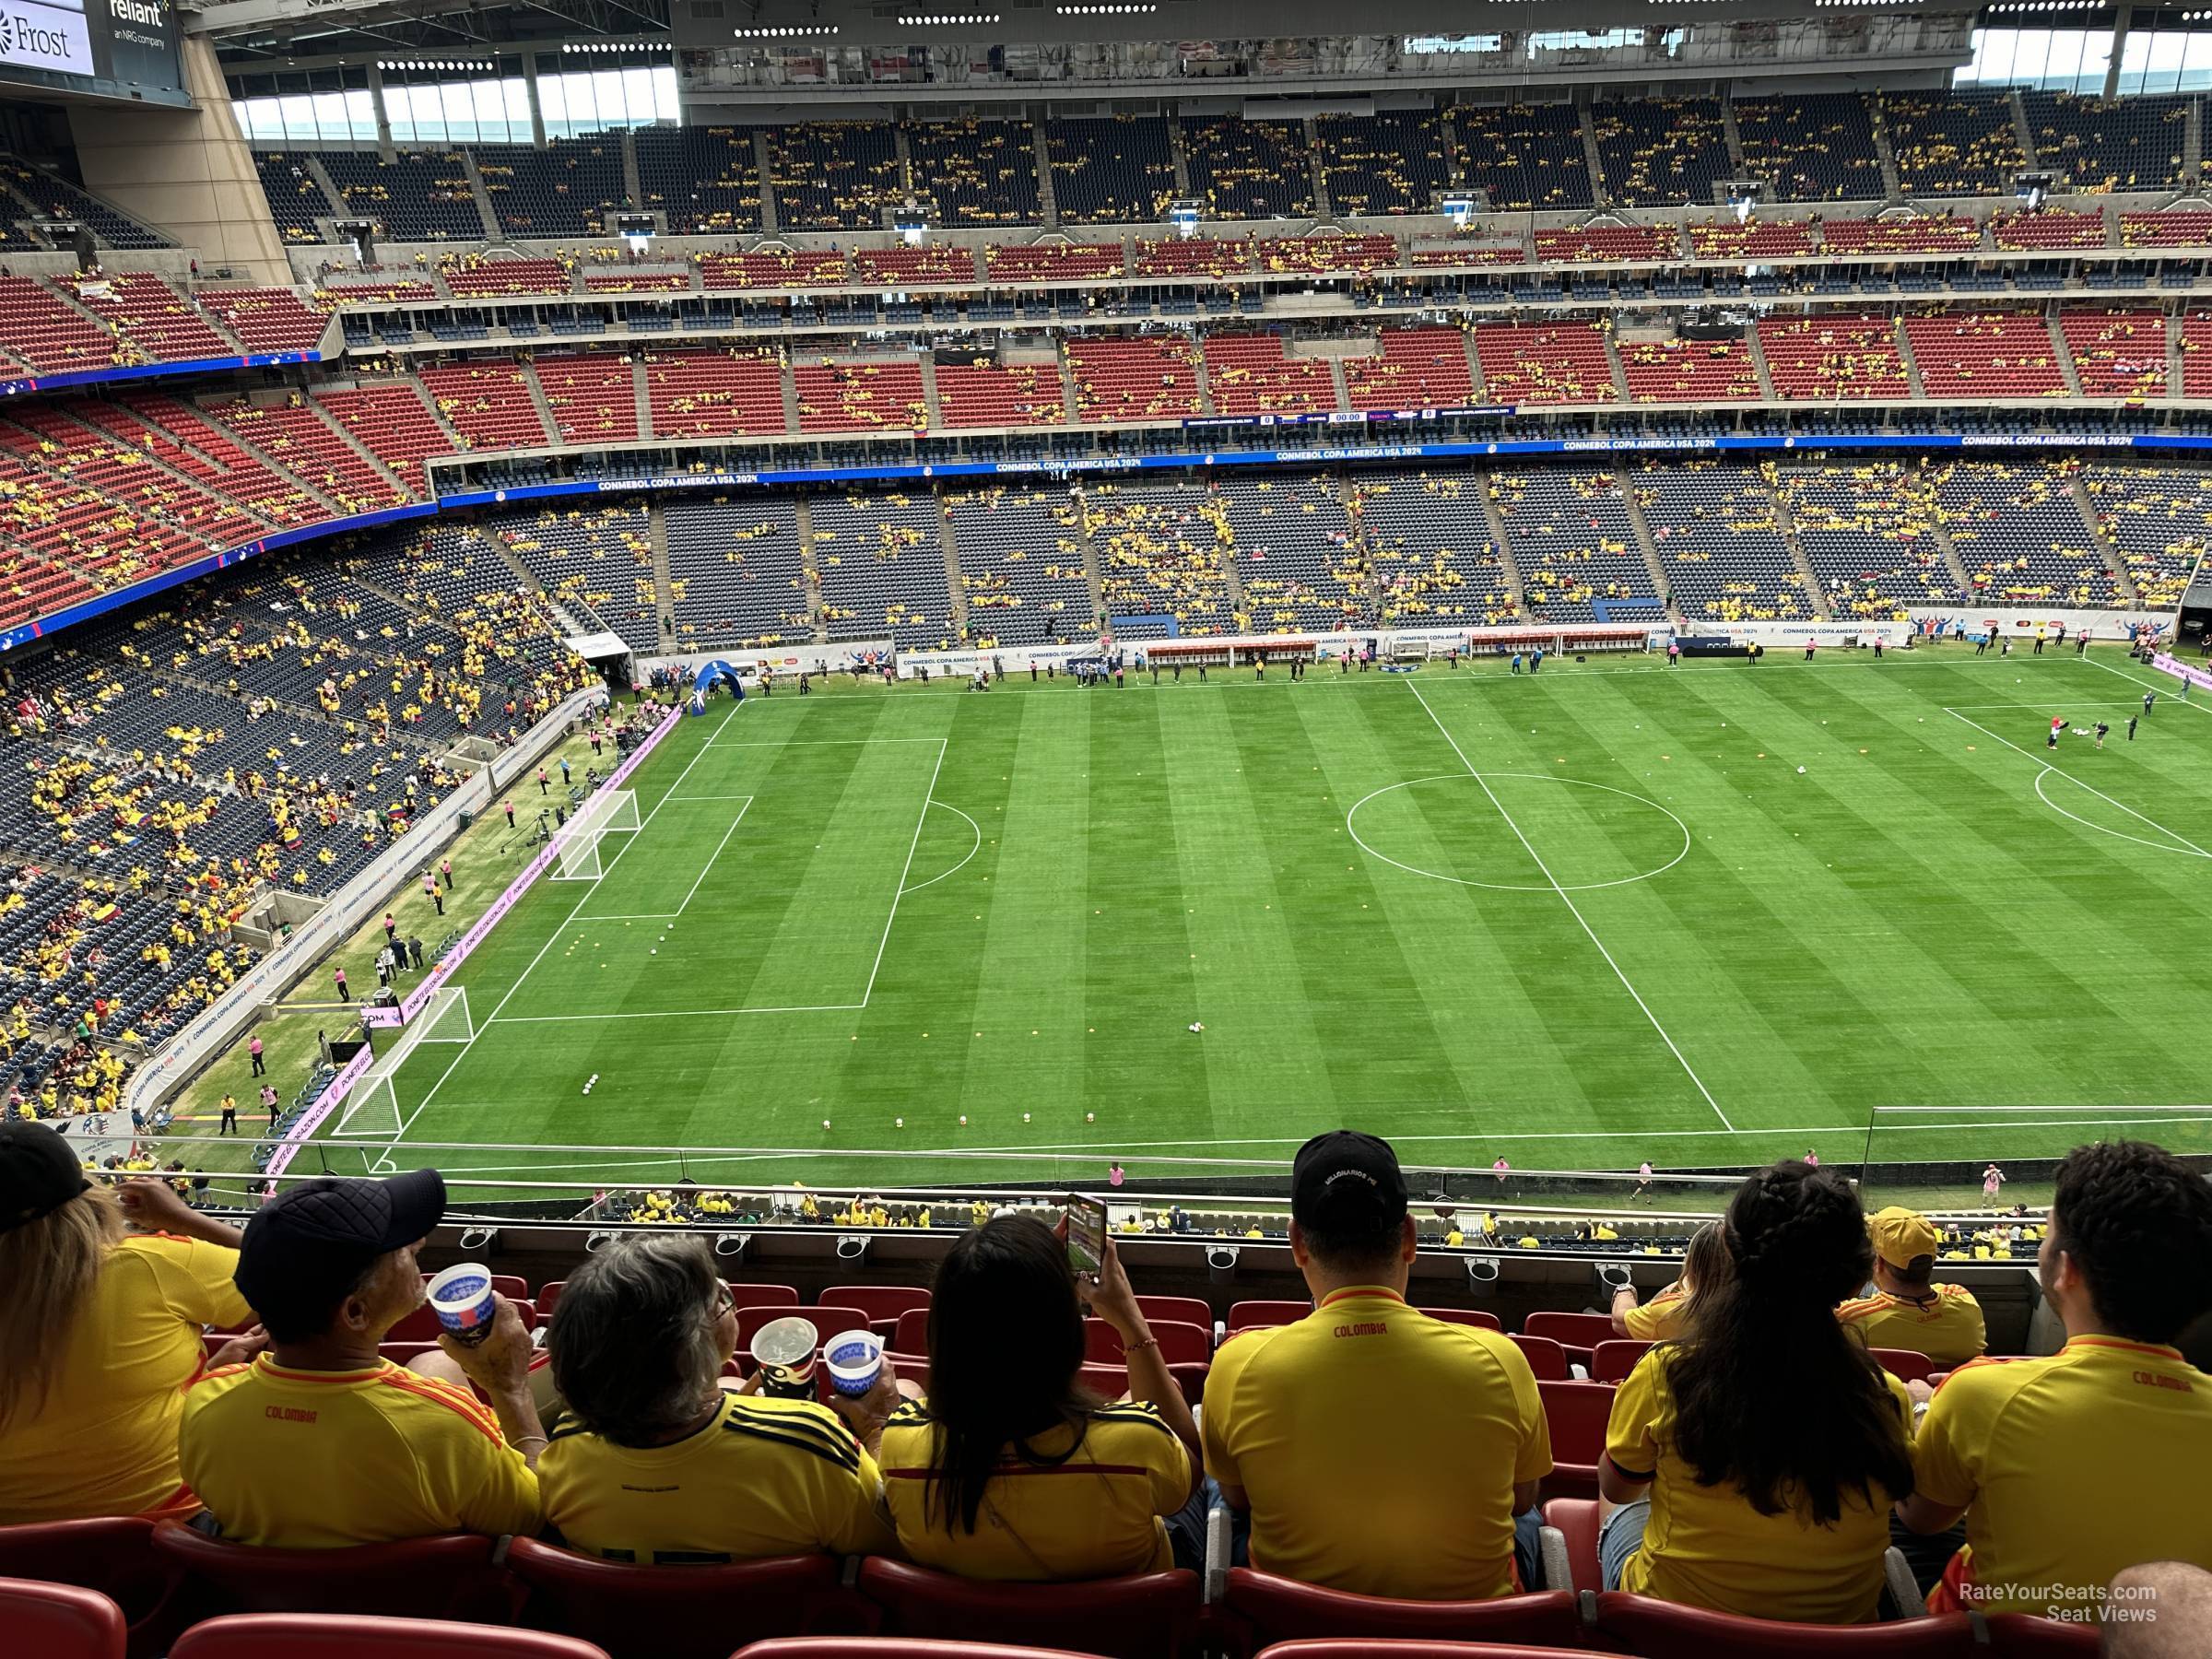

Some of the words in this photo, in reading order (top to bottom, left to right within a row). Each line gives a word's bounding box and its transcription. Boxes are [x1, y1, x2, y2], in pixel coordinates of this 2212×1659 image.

[110, 0, 163, 27] reliant
[13, 16, 71, 58] Frost
[114, 29, 124, 39] an
[123, 30, 137, 42] NRG
[137, 35, 165, 50] company
[1563, 441, 1612, 450] CONMEBOL
[1613, 441, 1637, 449] COPA
[1638, 440, 1676, 448] AMERICA
[1694, 439, 1716, 447] 2024
[1961, 436, 2015, 445] CONMEBOL
[2016, 436, 2041, 445] COPA
[2041, 436, 2086, 445] AMERICA
[2088, 436, 2107, 445] USA
[2107, 436, 2135, 445] 2024
[1277, 452, 1323, 461] CONMEBOL
[1324, 451, 1347, 459] COPA
[1347, 449, 1385, 458] AMERICA
[1385, 448, 1401, 456] USA
[1402, 447, 1422, 455] 2024
[996, 463, 1043, 472] CONMEBOL
[1043, 462, 1066, 470] COPA
[1066, 461, 1104, 469] AMERICA
[599, 481, 651, 491] CONMEBOL
[651, 478, 677, 488] COPA
[677, 477, 716, 487] AMERICA
[717, 476, 735, 484] USA
[736, 475, 758, 483] 2024
[193, 1017, 218, 1041] CONMEBOL
[1334, 1322, 1387, 1338] COLOMBIA
[265, 1406, 317, 1424] COLOMBIA
